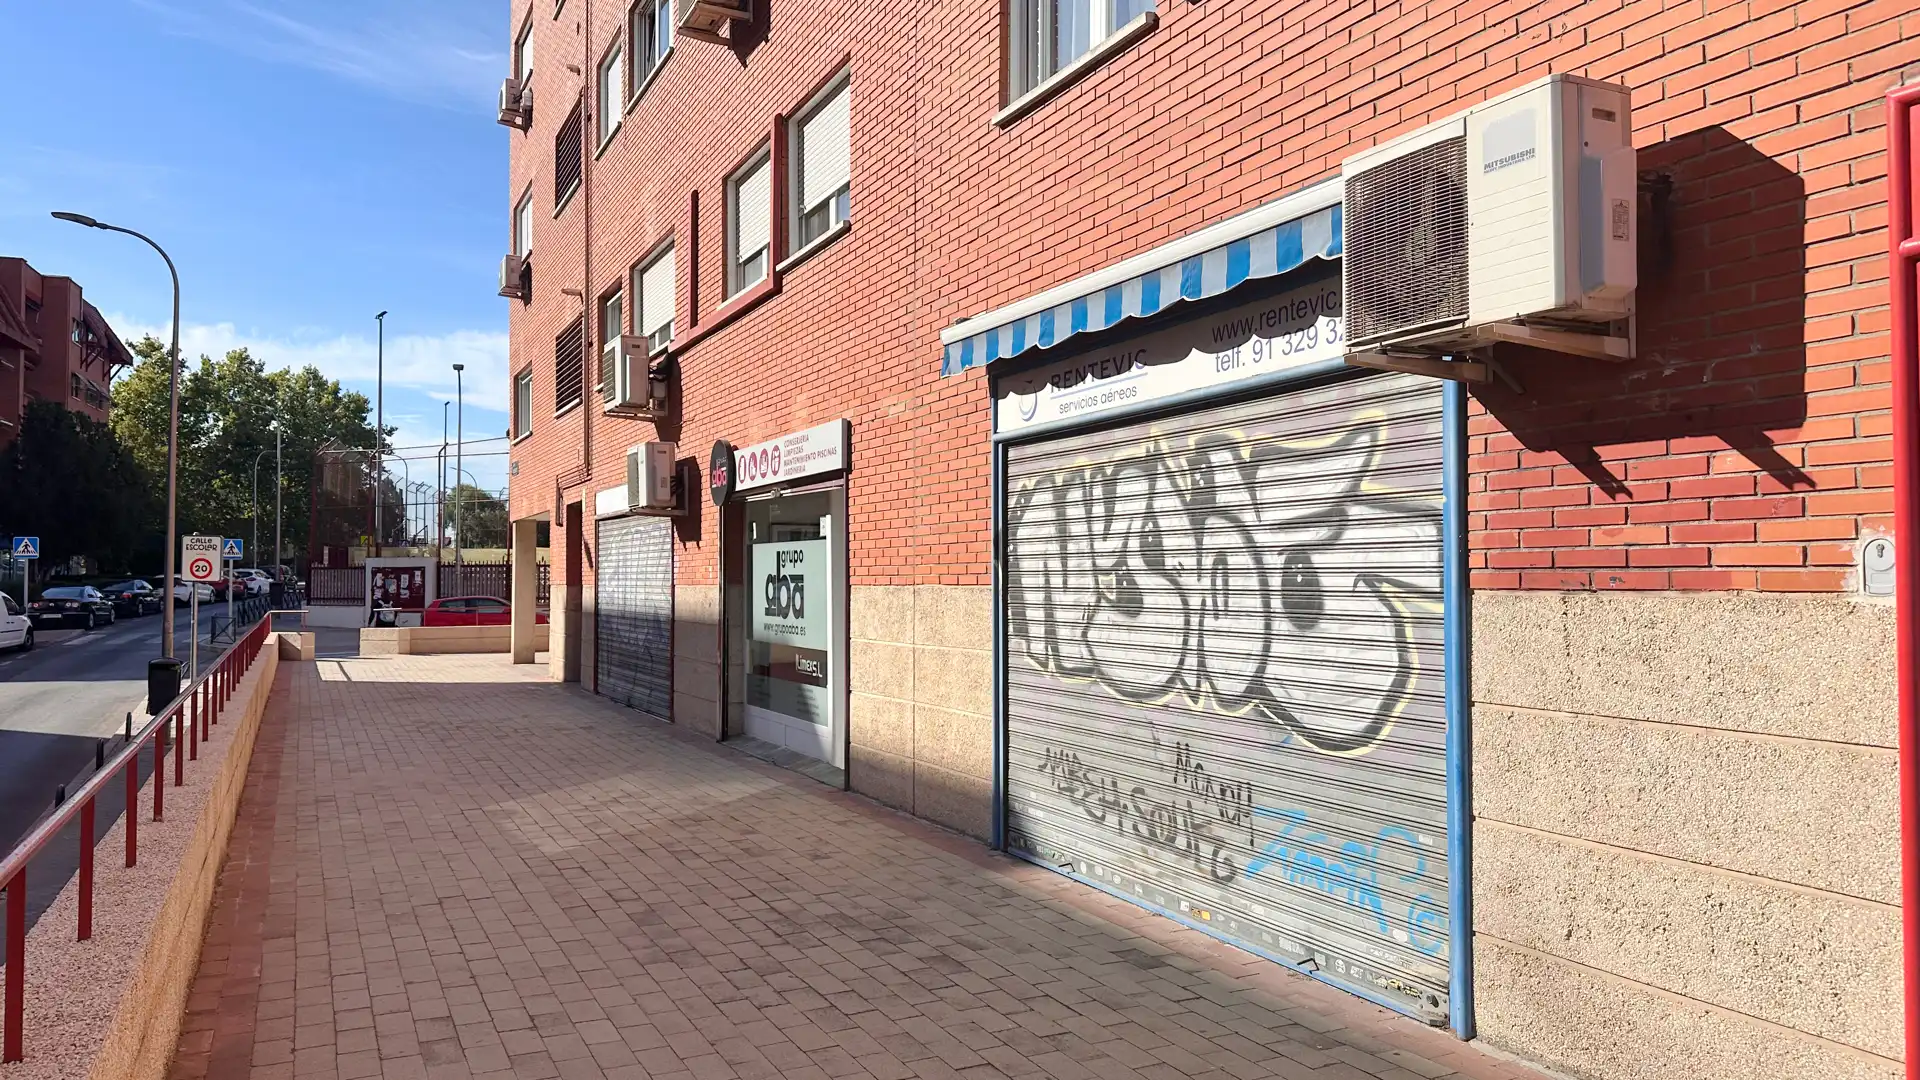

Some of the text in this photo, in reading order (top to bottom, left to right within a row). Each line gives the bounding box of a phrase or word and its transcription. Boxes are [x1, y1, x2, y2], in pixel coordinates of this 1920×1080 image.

[1484, 148, 1535, 170] MITSUBISHI
[1215, 317, 1343, 372] telf. 91 329 3
[1051, 348, 1147, 393] RENTEVIC
[1059, 386, 1137, 414] servicios aéreos
[784, 445, 804, 457] LIMPIEZAS
[784, 446, 837, 467] MANTENIMIENTO PISCINAS
[781, 549, 804, 568] grupo
[765, 551, 804, 619] aba
[764, 622, 807, 636] www.grupoaba.es
